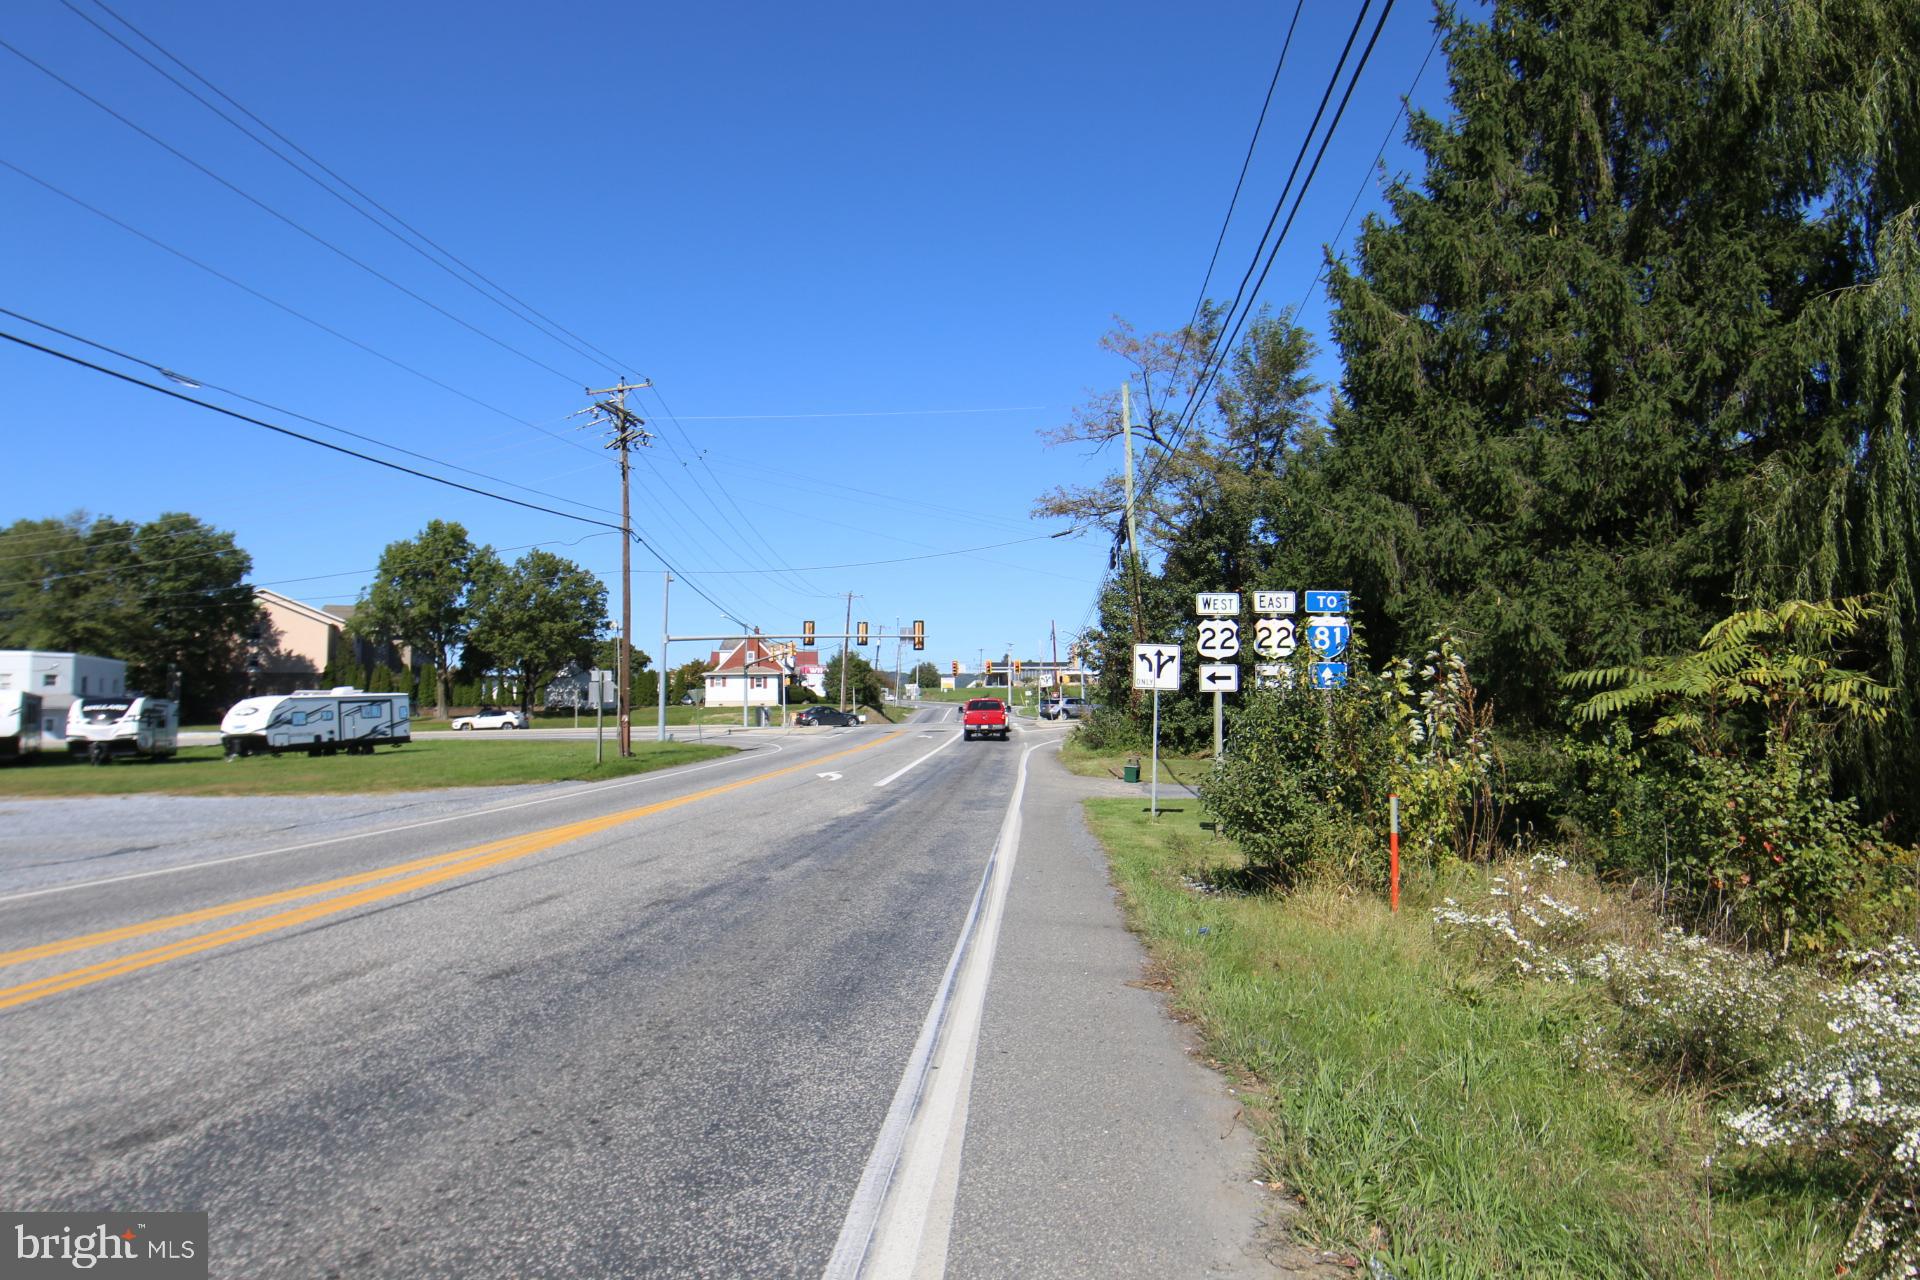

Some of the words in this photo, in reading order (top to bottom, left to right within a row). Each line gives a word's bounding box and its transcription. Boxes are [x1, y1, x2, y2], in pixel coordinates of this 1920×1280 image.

[1202, 596, 1234, 610] WEST
[1259, 595, 1289, 609] EAST
[1316, 595, 1338, 608] TO
[1201, 627, 1235, 650] 22
[1257, 626, 1292, 649] 22
[1315, 626, 1342, 651] 81
[1136, 678, 1154, 686] ONLY
